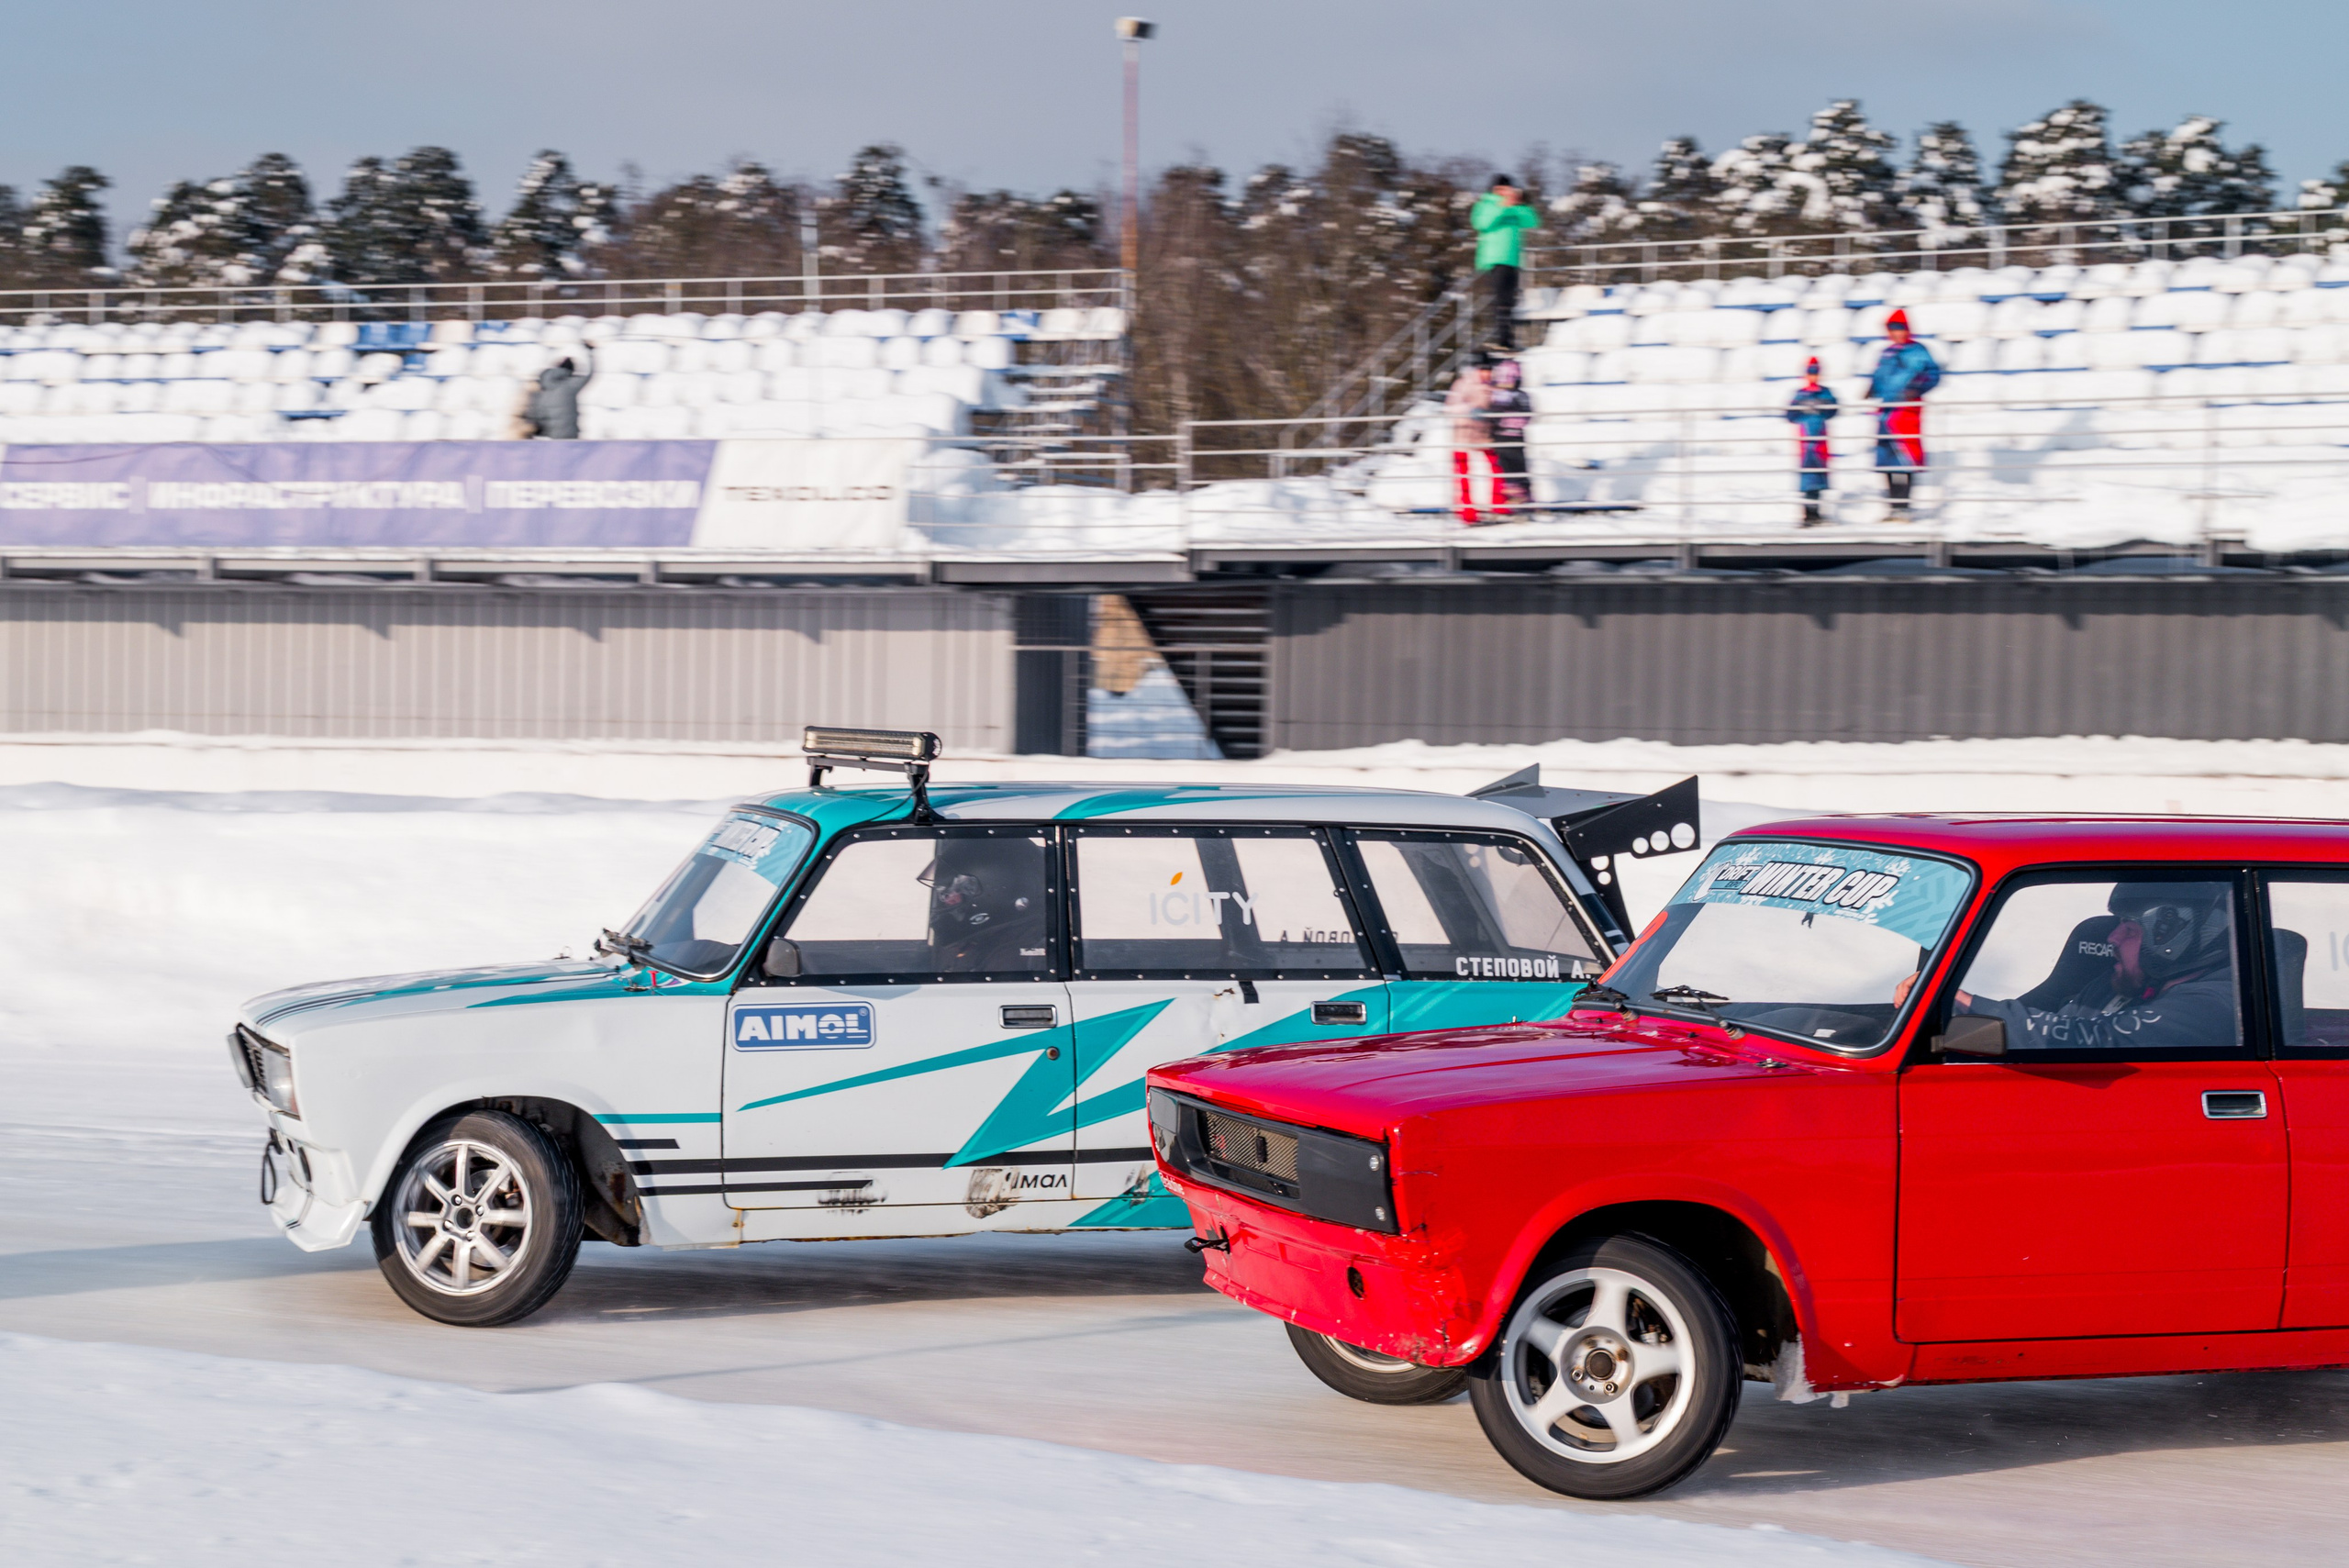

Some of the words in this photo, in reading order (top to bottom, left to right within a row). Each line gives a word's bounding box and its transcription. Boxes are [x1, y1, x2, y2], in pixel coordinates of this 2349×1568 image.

[1716, 864, 1764, 881] DRIFT
[1739, 861, 1847, 902] WINTER
[1822, 868, 1899, 909] CUP
[1149, 891, 1259, 926] ICITY
[2078, 940, 2114, 957] RECAR
[1455, 954, 1560, 979] СТЕПОВОЙ
[1571, 960, 1592, 980] А.
[737, 1013, 869, 1041] AIMOL
